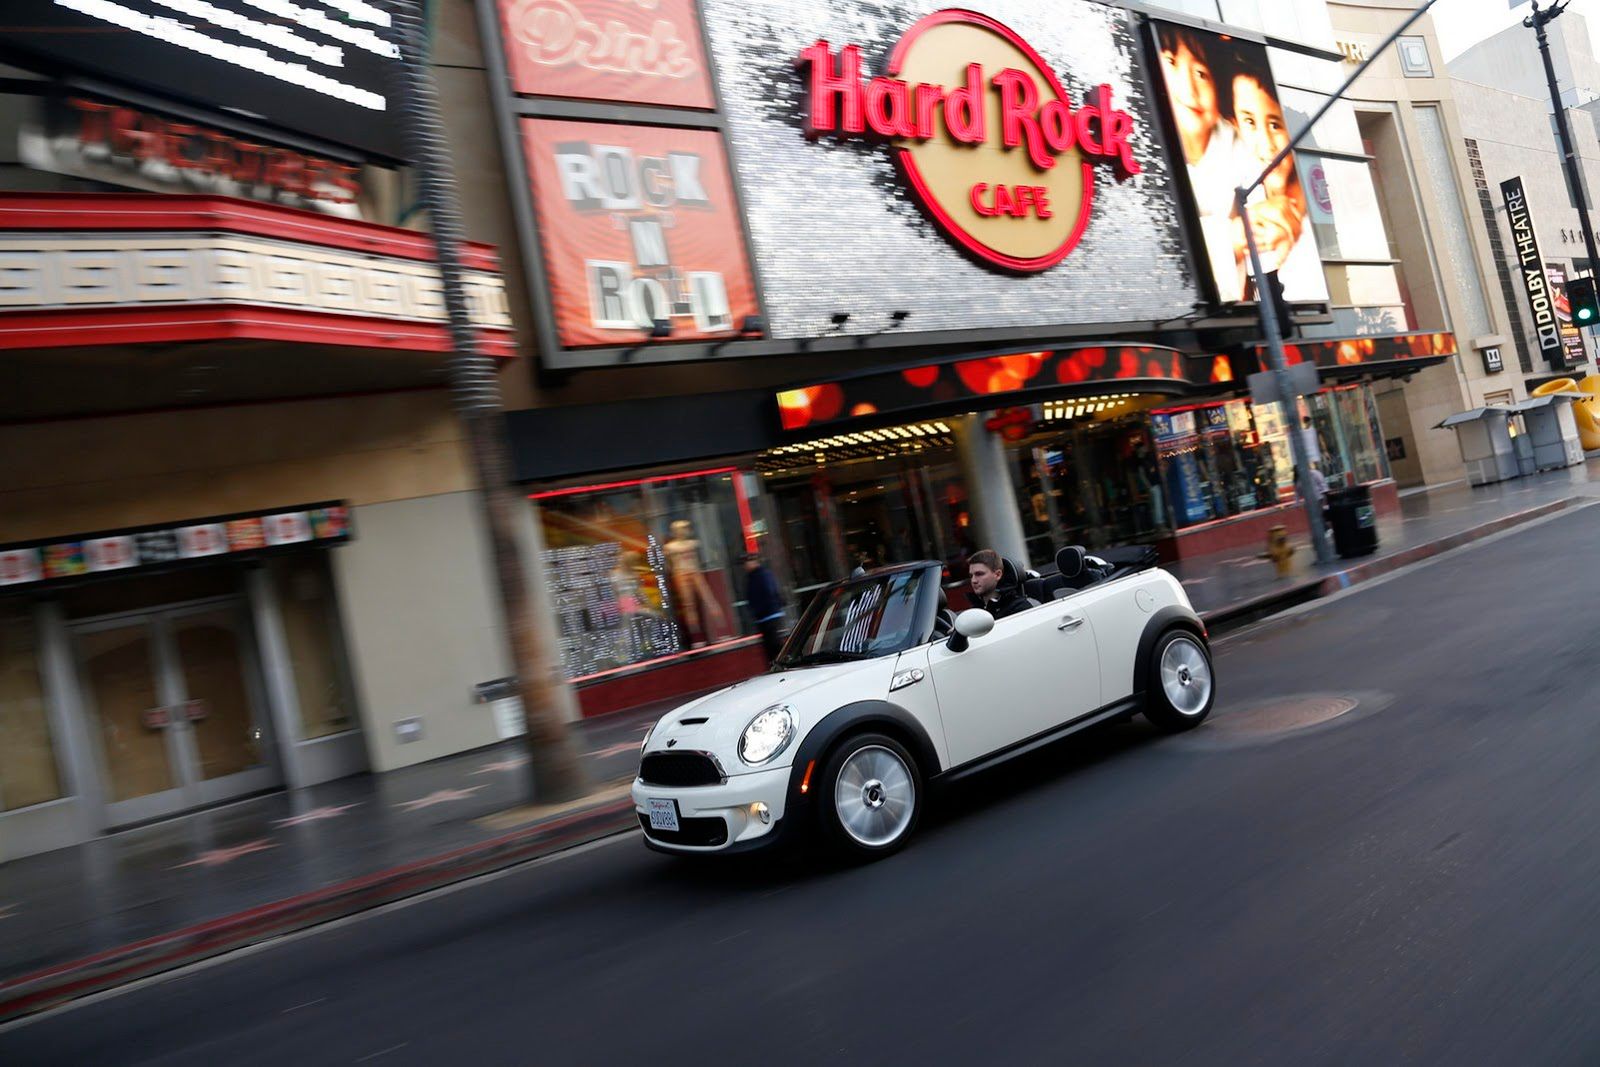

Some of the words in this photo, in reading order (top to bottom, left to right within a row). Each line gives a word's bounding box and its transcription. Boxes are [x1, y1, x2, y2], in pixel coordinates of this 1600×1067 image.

[800, 39, 987, 144] Hard
[992, 67, 1141, 175] Rock
[554, 141, 712, 210] ROCK
[969, 182, 1054, 219] CAFE
[1506, 187, 1535, 266] THEATRE
[1526, 269, 1551, 325] DOLBY
